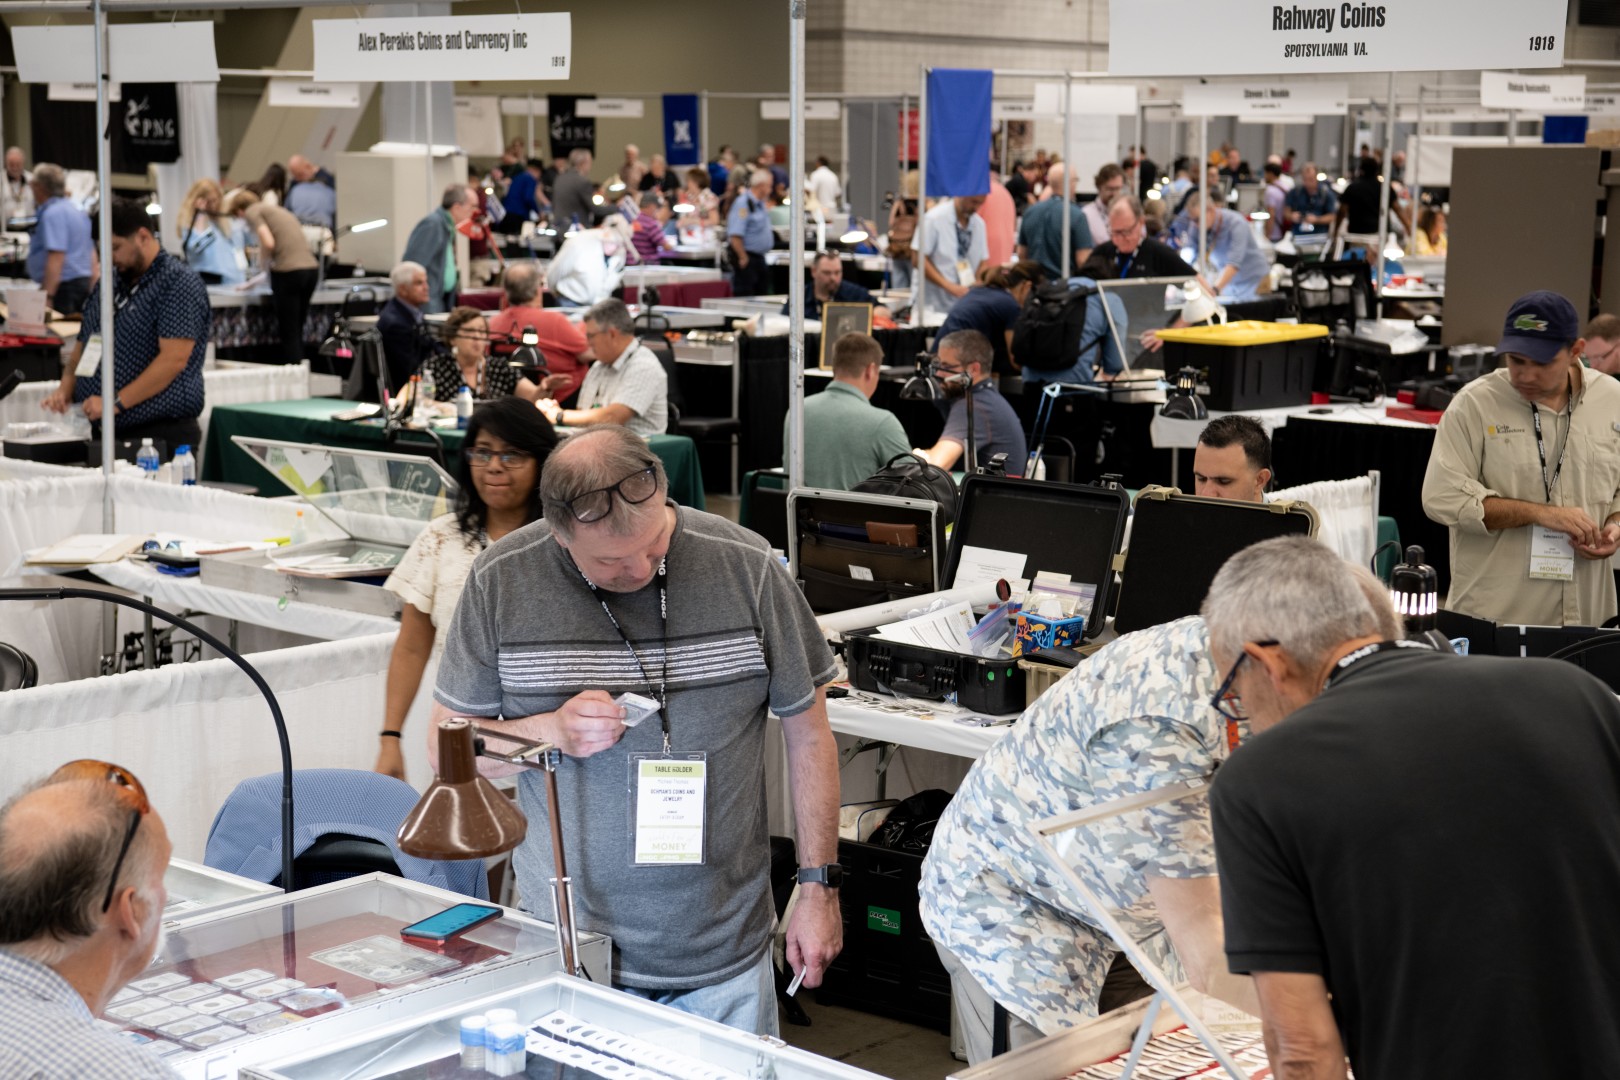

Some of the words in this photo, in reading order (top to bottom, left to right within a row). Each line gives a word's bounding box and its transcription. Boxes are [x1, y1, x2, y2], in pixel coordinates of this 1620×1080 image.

[1272, 5, 1336, 33] Rahway
[1340, 2, 1386, 30] Coins
[358, 32, 378, 51] Alex
[379, 31, 415, 51] Perakis
[417, 31, 443, 50] Coins
[445, 30, 463, 50] and
[464, 30, 510, 52] Currency
[512, 29, 528, 49] inc
[1284, 42, 1348, 58] SPOTSYLVANIA
[1353, 42, 1369, 56] VA.
[1528, 36, 1555, 51] 1918
[142, 118, 175, 138] PNG
[658, 555, 667, 576] MG
[652, 842, 687, 851] MONEY
